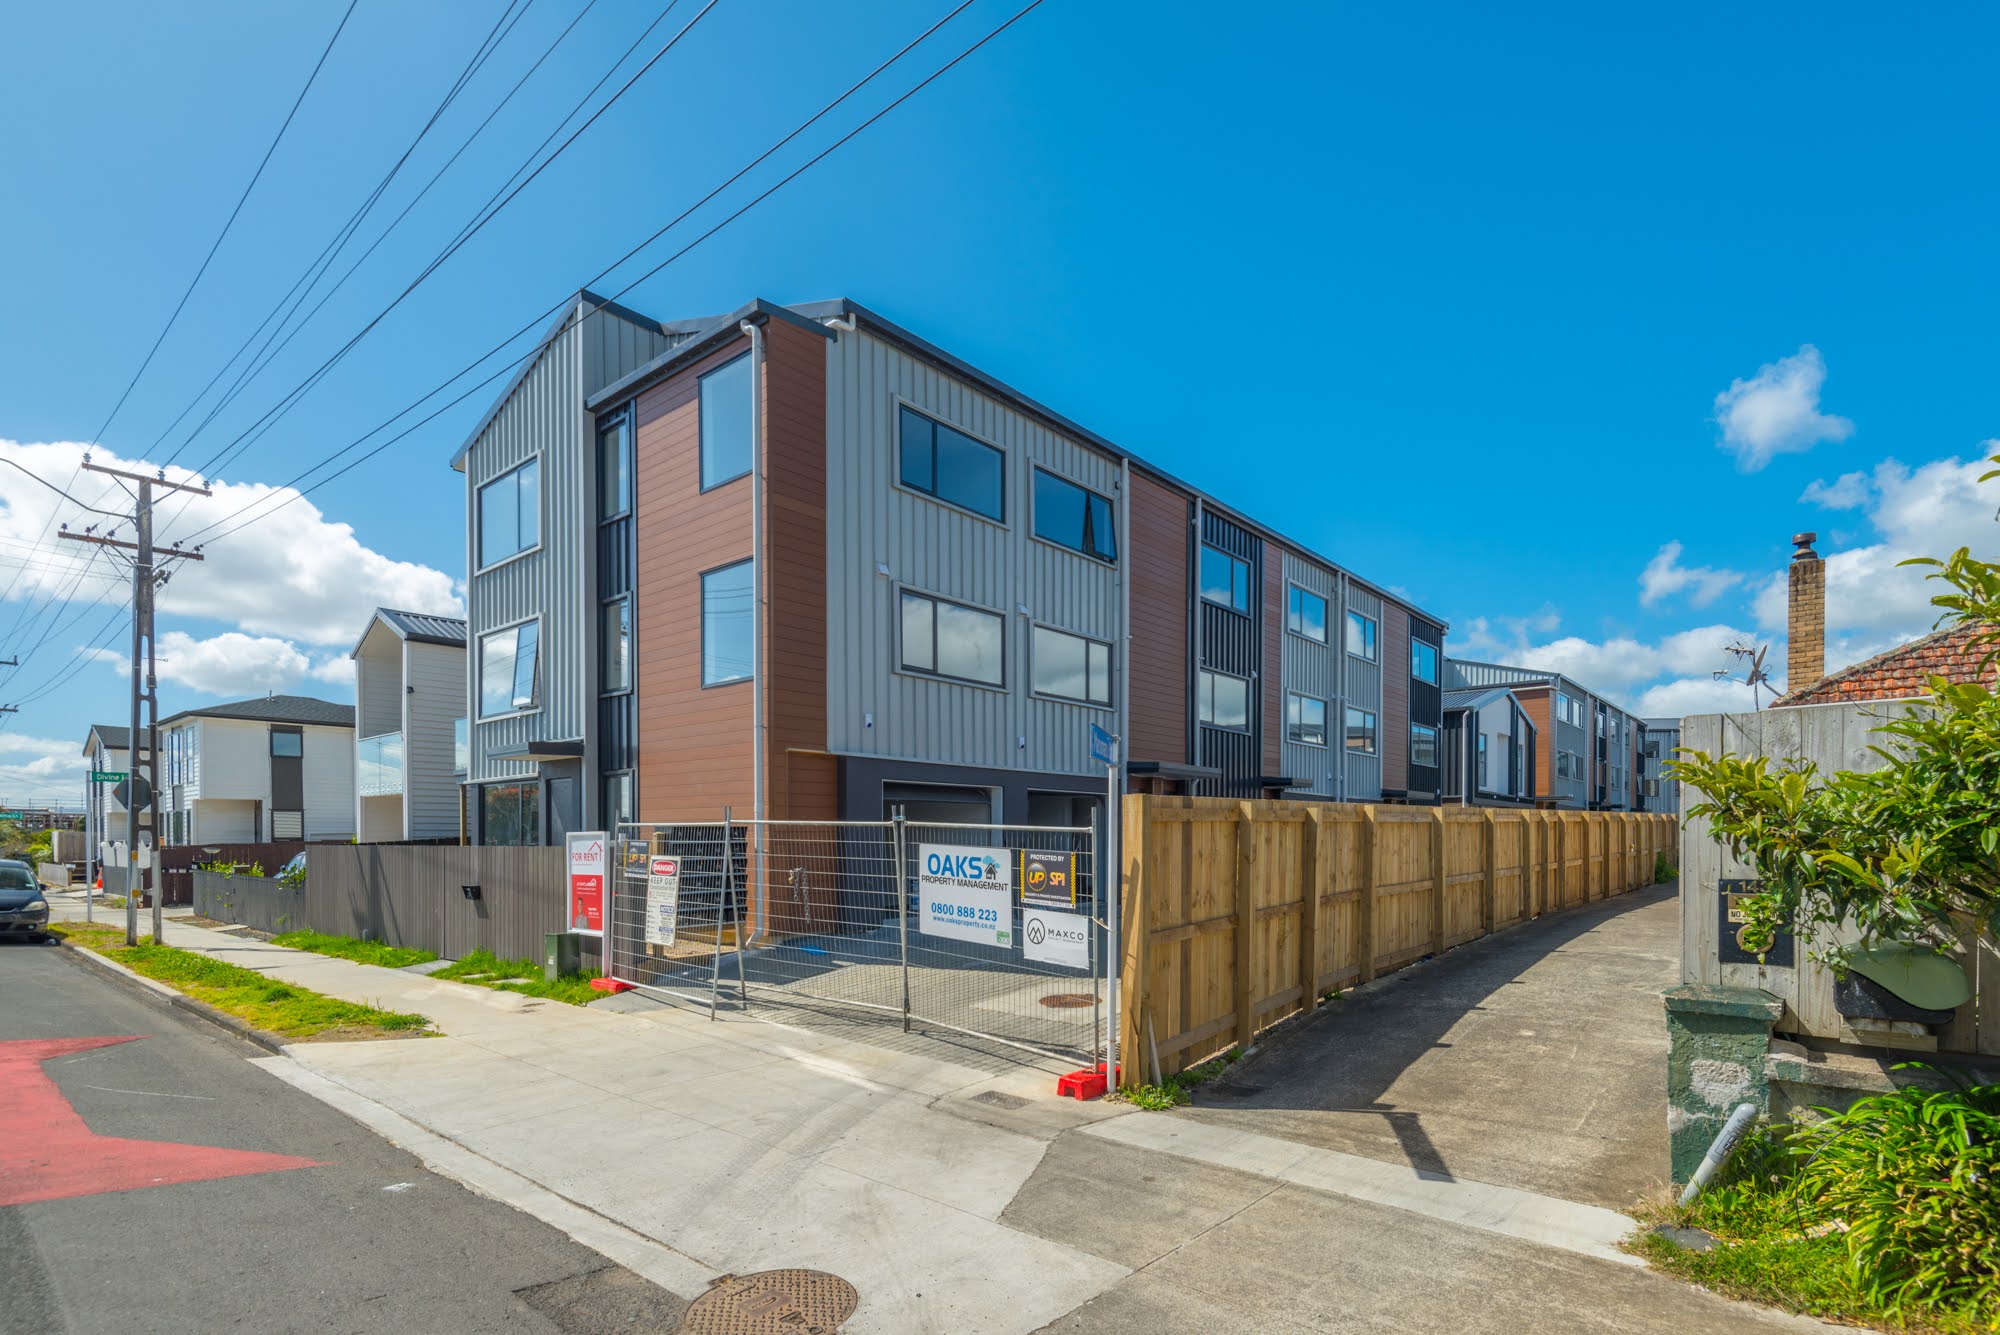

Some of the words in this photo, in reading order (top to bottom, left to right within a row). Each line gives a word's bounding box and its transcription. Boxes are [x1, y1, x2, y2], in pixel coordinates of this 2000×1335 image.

[96, 773, 120, 781] Divine
[572, 852, 583, 862] FOR
[584, 852, 598, 862] RENT
[1030, 853, 1057, 861] PROTECTED
[653, 863, 675, 872] DANGER
[927, 853, 983, 880] OAKS
[650, 877, 663, 885] KEEP
[664, 878, 676, 886] OUT
[921, 874, 956, 887] PROPERTY
[957, 878, 1009, 892] MANAGEMENT
[1028, 871, 1045, 884] UP
[1050, 871, 1066, 887] SPI
[931, 902, 954, 916] 0800
[957, 905, 975, 919] 888
[978, 908, 998, 922] 223
[1731, 910, 1741, 918] NO
[933, 915, 996, 930] www.oaksproperty.co.nz
[1047, 928, 1084, 941] MAXCO
